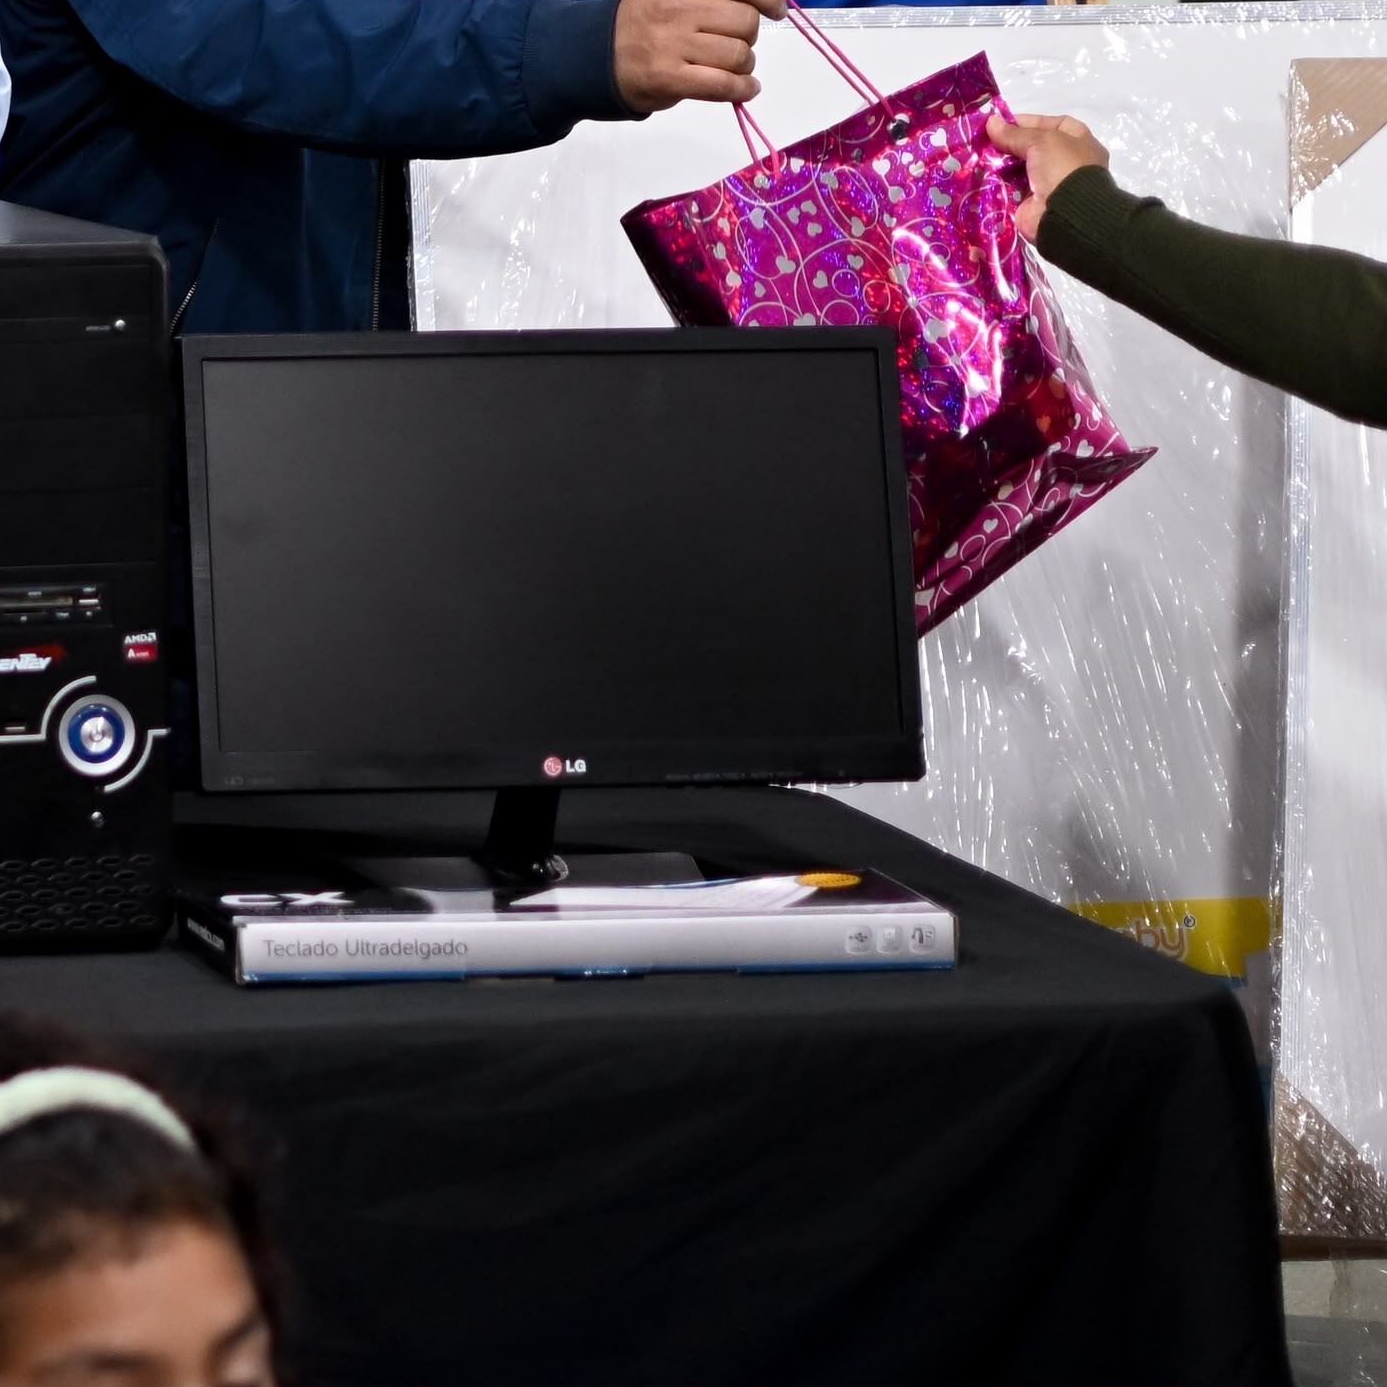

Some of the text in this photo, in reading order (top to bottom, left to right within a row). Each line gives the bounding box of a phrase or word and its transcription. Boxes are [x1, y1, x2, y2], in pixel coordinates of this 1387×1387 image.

[124, 633, 148, 644] AMD
[565, 759, 587, 773] LG
[220, 891, 355, 907] CX
[262, 938, 469, 960] Teclado Ultradelgado
